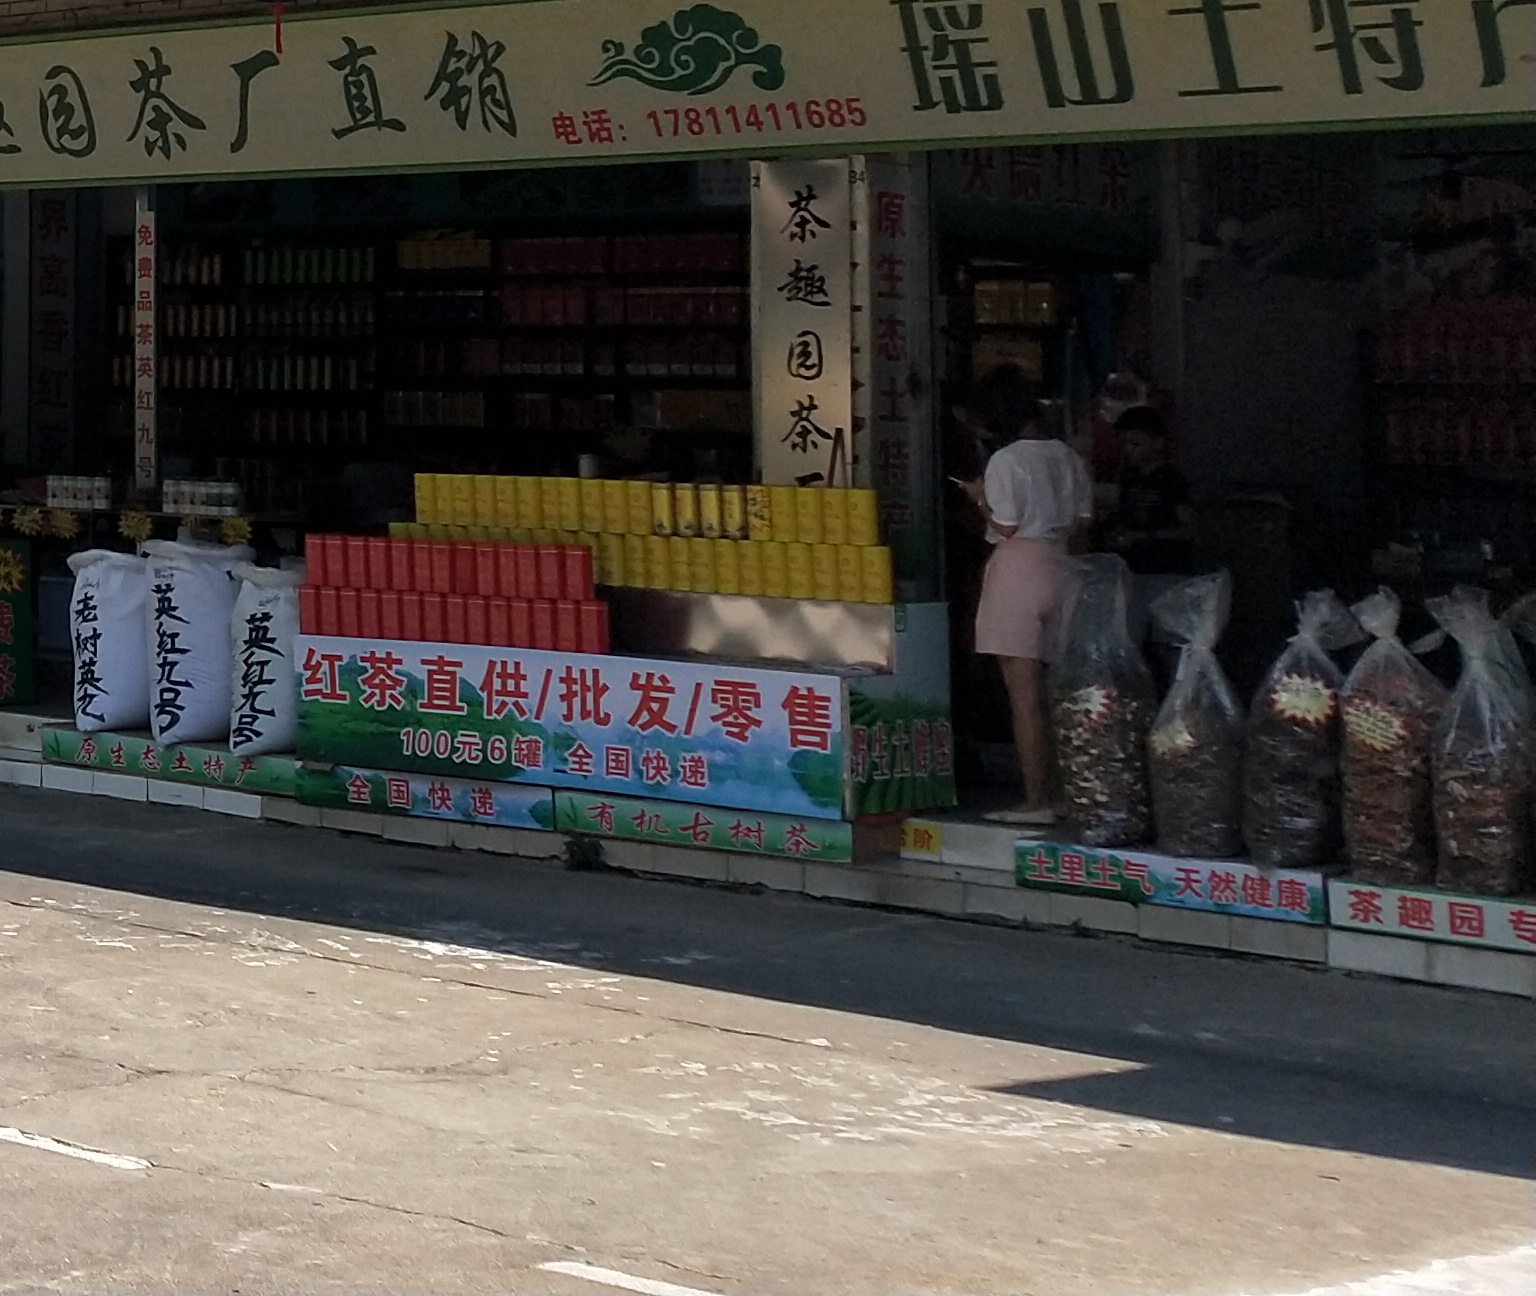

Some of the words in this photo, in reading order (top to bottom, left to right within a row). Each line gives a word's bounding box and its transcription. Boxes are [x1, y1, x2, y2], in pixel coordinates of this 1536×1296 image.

[136, 224, 155, 480] 免费品茶英红九号
[74, 591, 111, 724] 老树英九
[150, 582, 197, 737] 英红九号
[232, 611, 287, 750] 英红九号
[301, 646, 835, 752] 红茶直供/批发/零售
[74, 735, 260, 785] 原生态土特产
[401, 726, 545, 771] 100元6罐
[566, 744, 710, 789] 全国快递
[345, 773, 497, 818] 全国快递
[587, 801, 823, 858] 有机古树茶
[1028, 849, 1154, 897] 土里土气
[1173, 865, 1311, 914] 天然健康
[1348, 888, 1486, 939] 茶趣园
